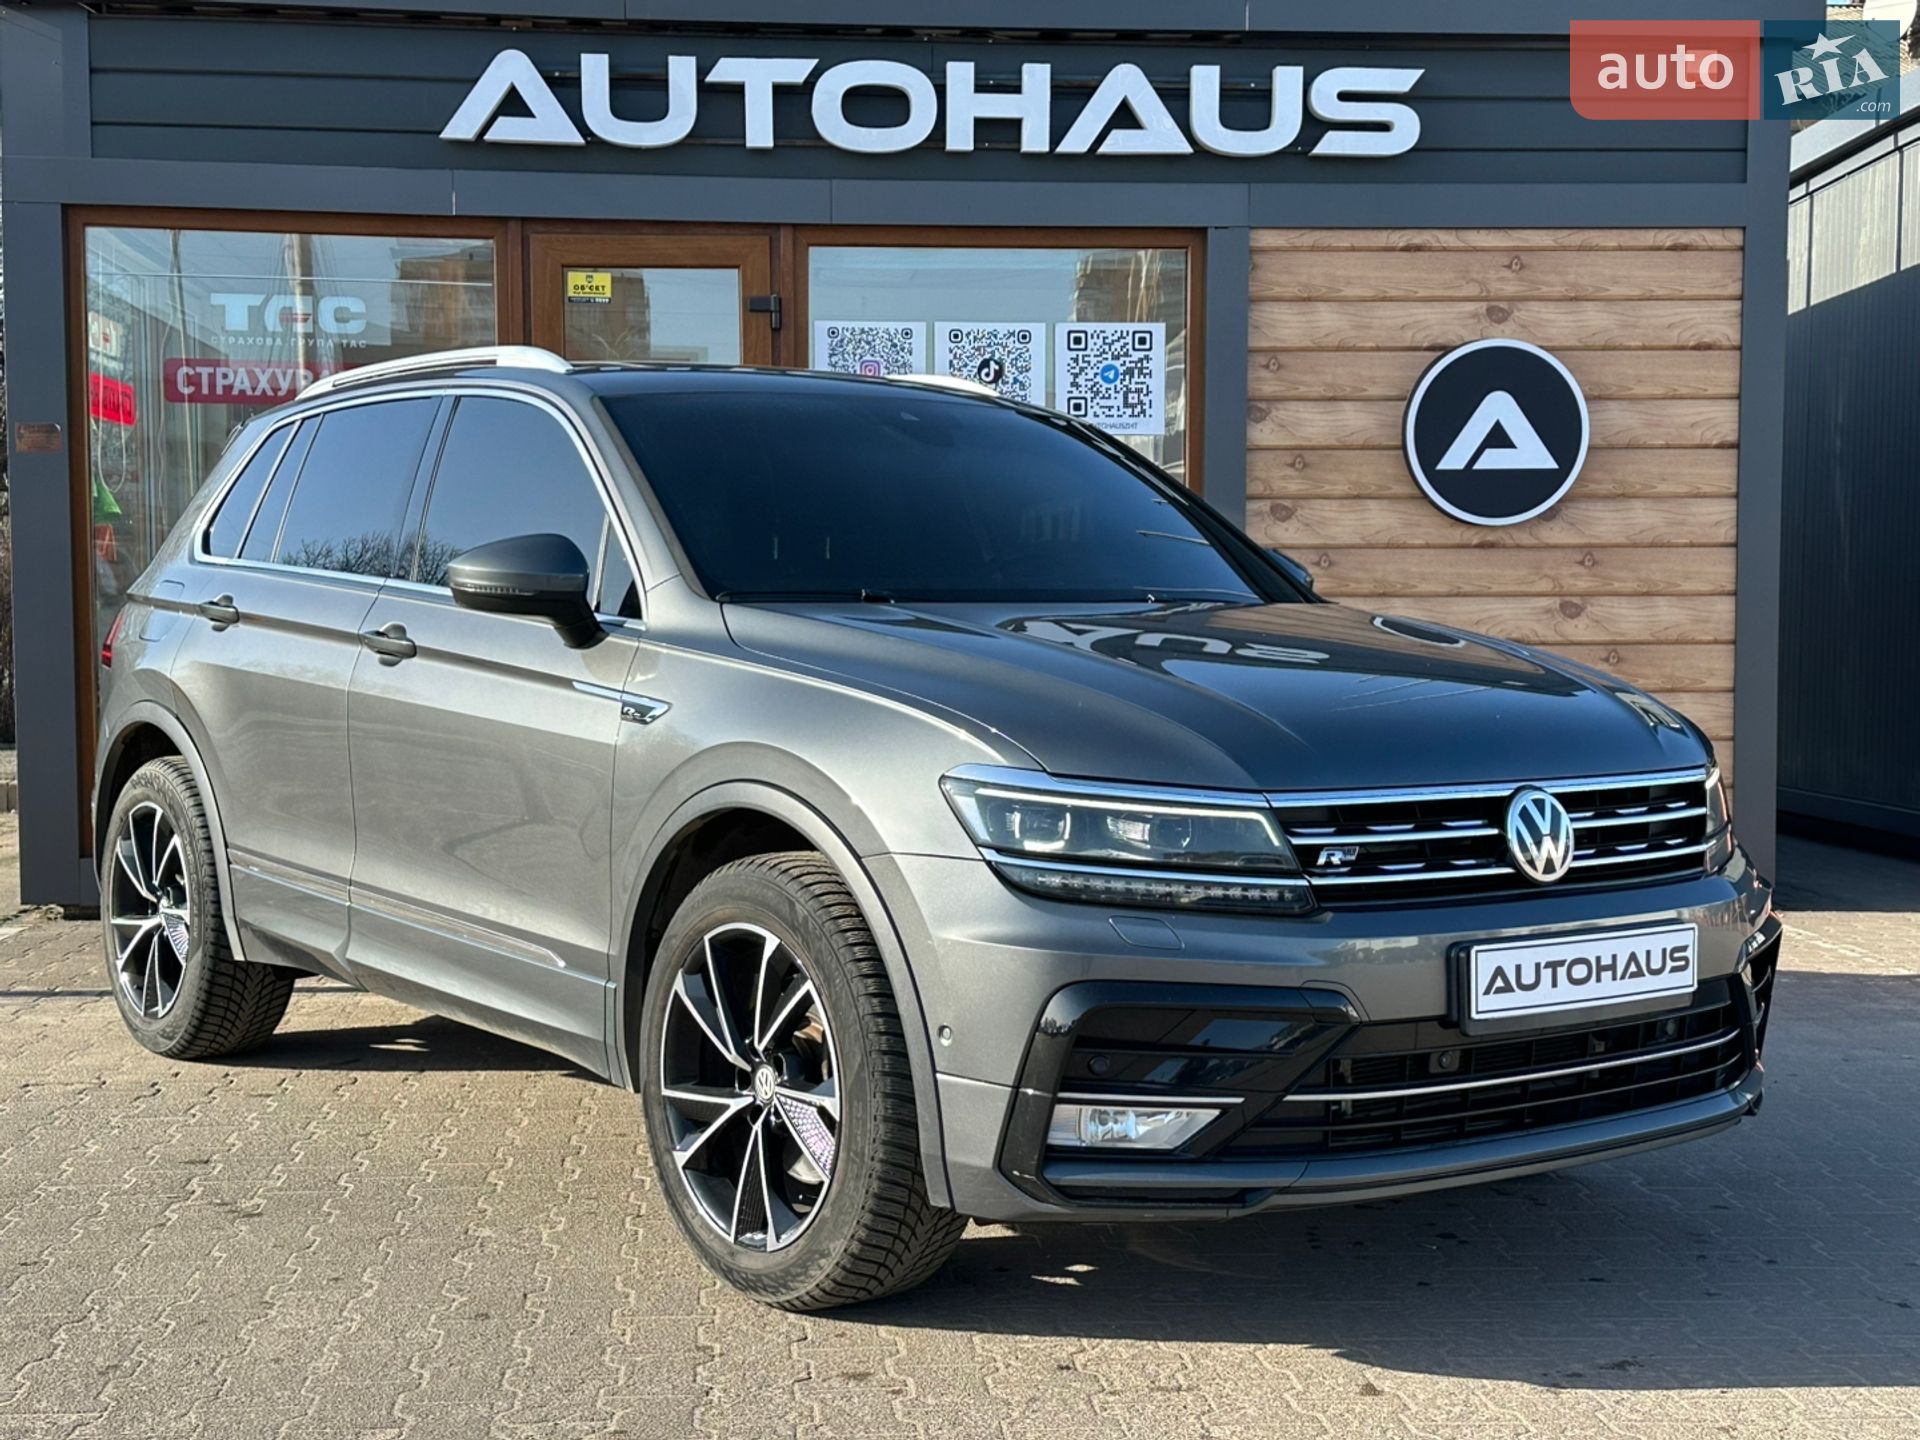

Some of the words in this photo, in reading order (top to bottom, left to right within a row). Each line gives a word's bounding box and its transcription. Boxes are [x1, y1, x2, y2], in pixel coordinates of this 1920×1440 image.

[438, 48, 1425, 158] AUTOHAUS
[210, 336, 282, 347] СТРАХОВА
[1481, 945, 1690, 996] AUTOHAUS
